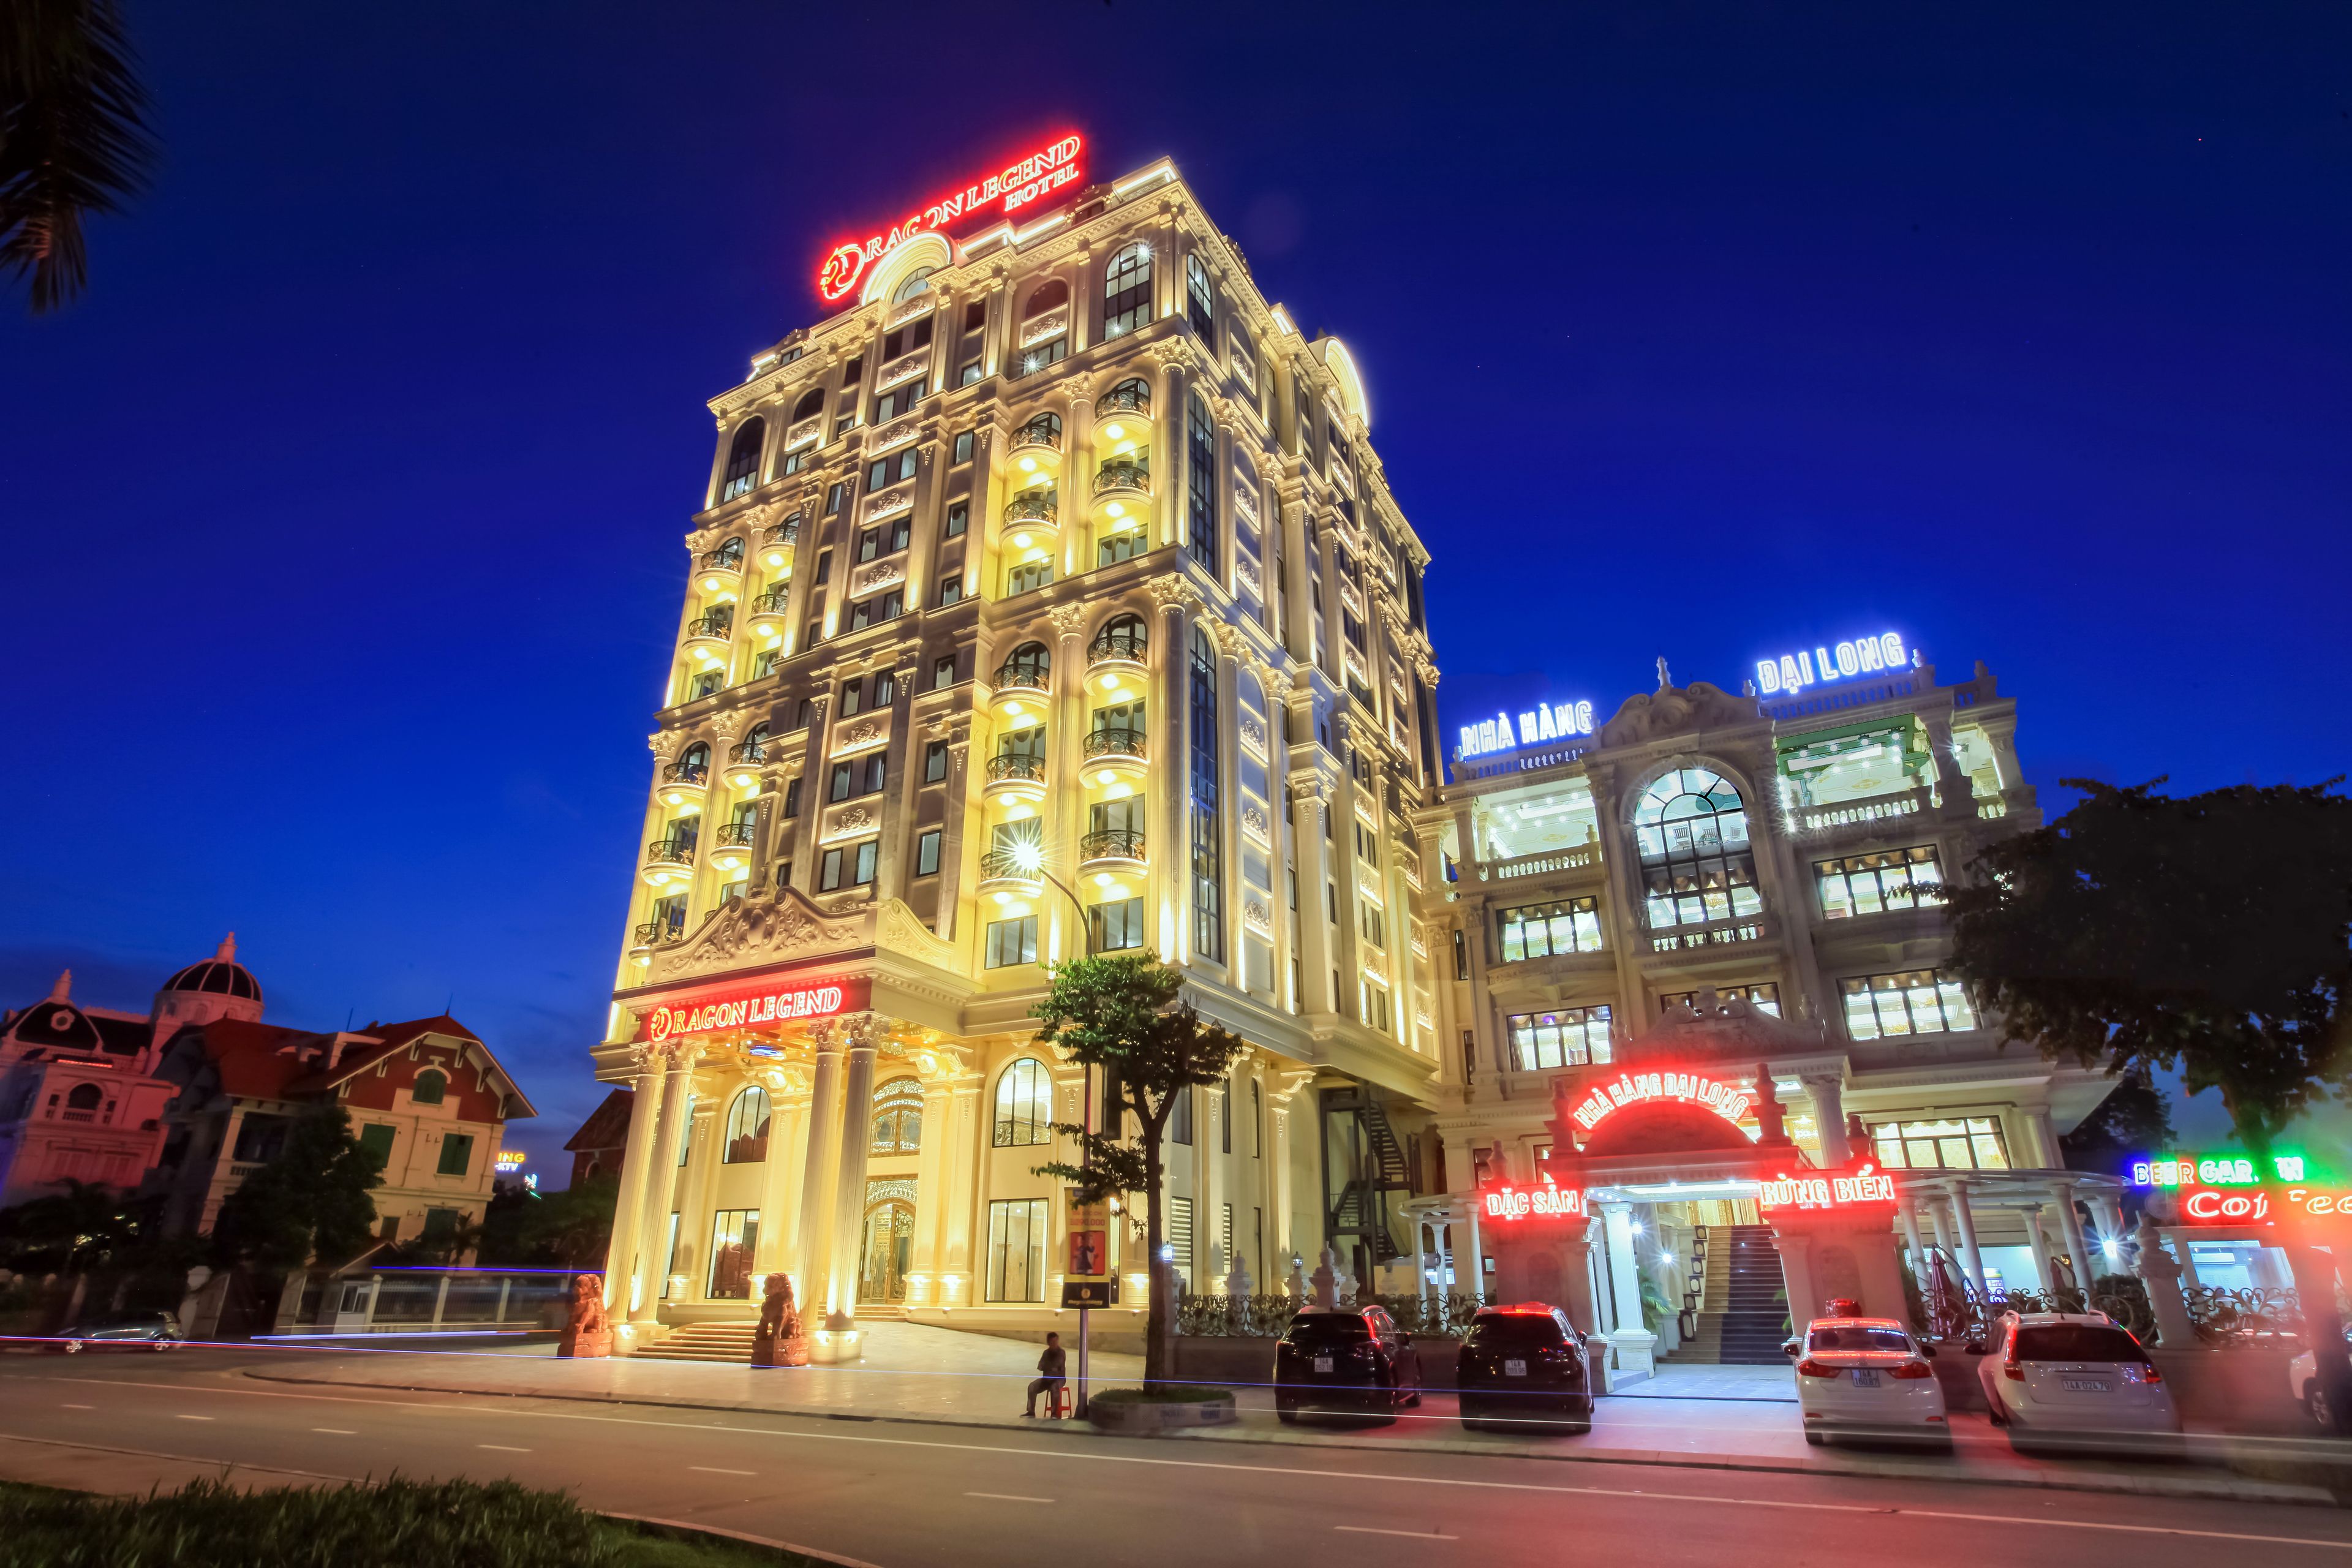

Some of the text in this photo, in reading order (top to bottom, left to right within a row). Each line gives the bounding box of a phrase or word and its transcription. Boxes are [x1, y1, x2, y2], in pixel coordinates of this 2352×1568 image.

[966, 135, 1081, 211] LEGEND
[1005, 163, 1079, 212] HOTEL
[1757, 632, 1906, 694] ĐẠI LONG
[1460, 701, 1593, 756] NHÀ HÀNG
[650, 986, 842, 1042] DRAGON LEGEND
[1573, 1073, 1749, 1129] NHÀ HÀNG ĐẠI LONG
[2133, 1159, 2194, 1185] BEER
[1487, 1184, 1579, 1220] ĐẶC SẢN
